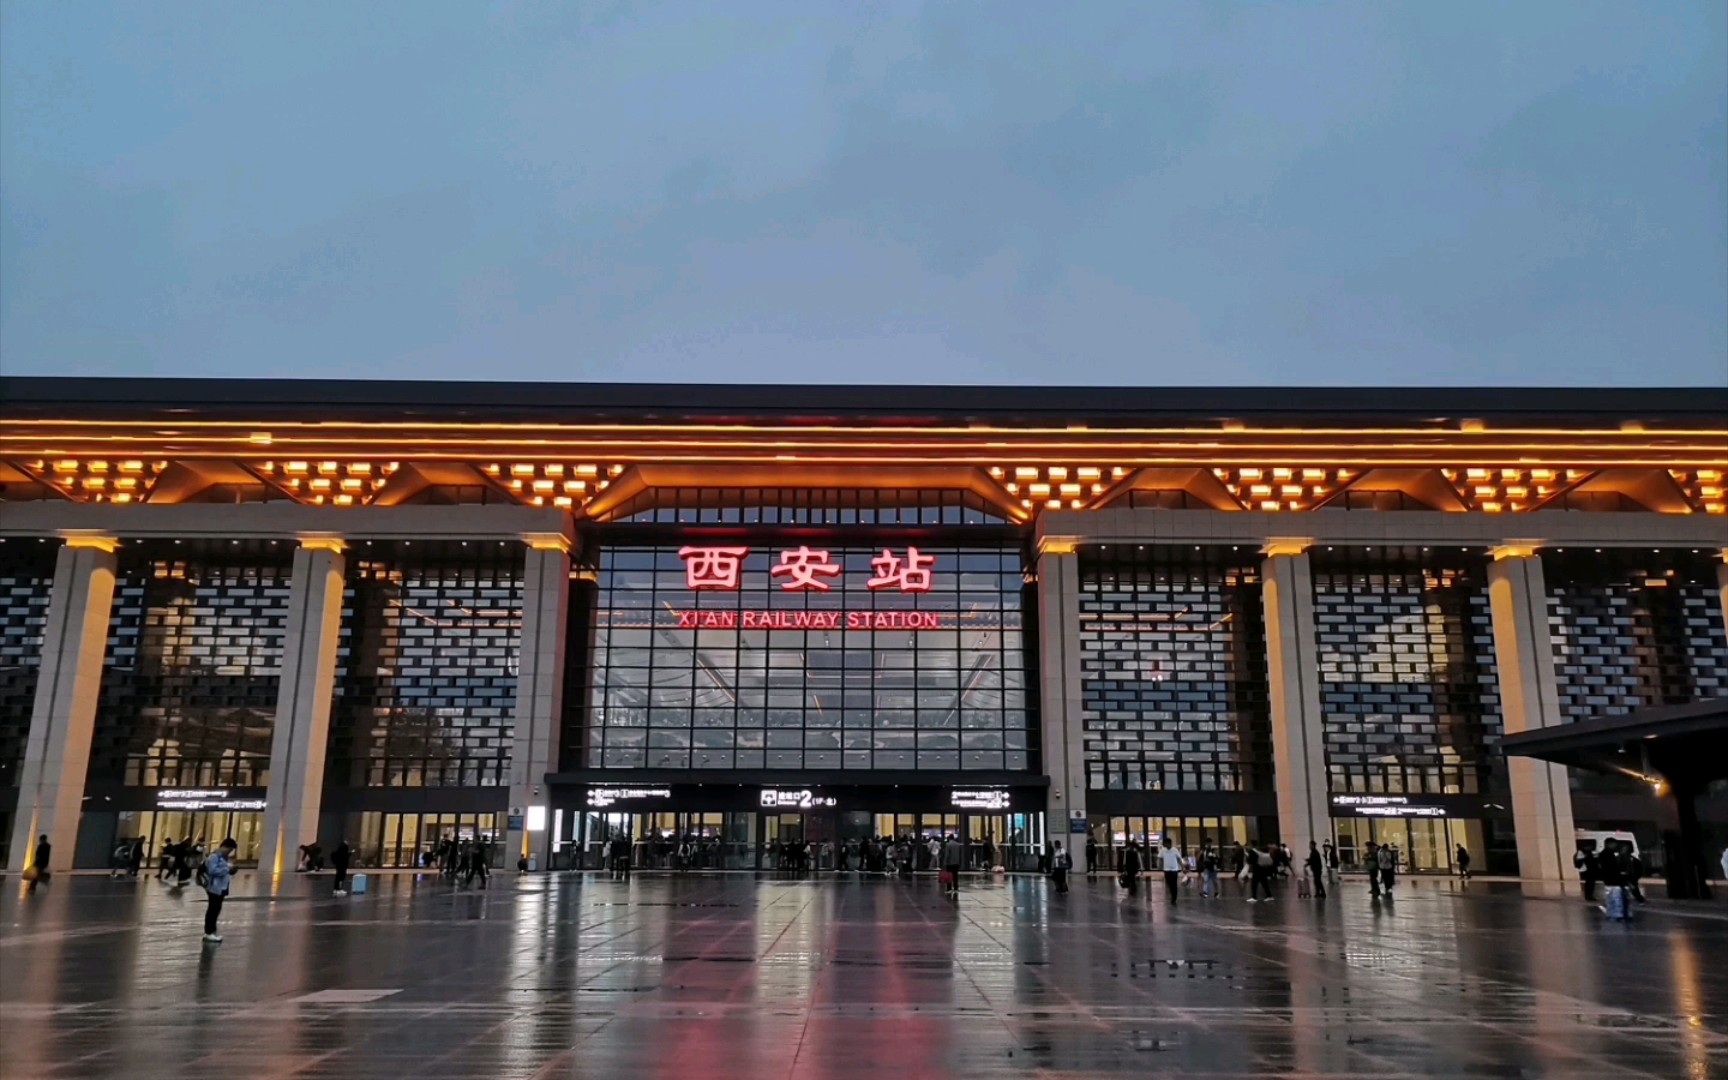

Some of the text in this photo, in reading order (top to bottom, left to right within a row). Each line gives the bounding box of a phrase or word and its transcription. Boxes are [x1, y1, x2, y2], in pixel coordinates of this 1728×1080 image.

[678, 546, 934, 592] 西安站
[743, 611, 840, 628] RAILWAY
[848, 611, 938, 628] STATION
[800, 790, 812, 807] 2
